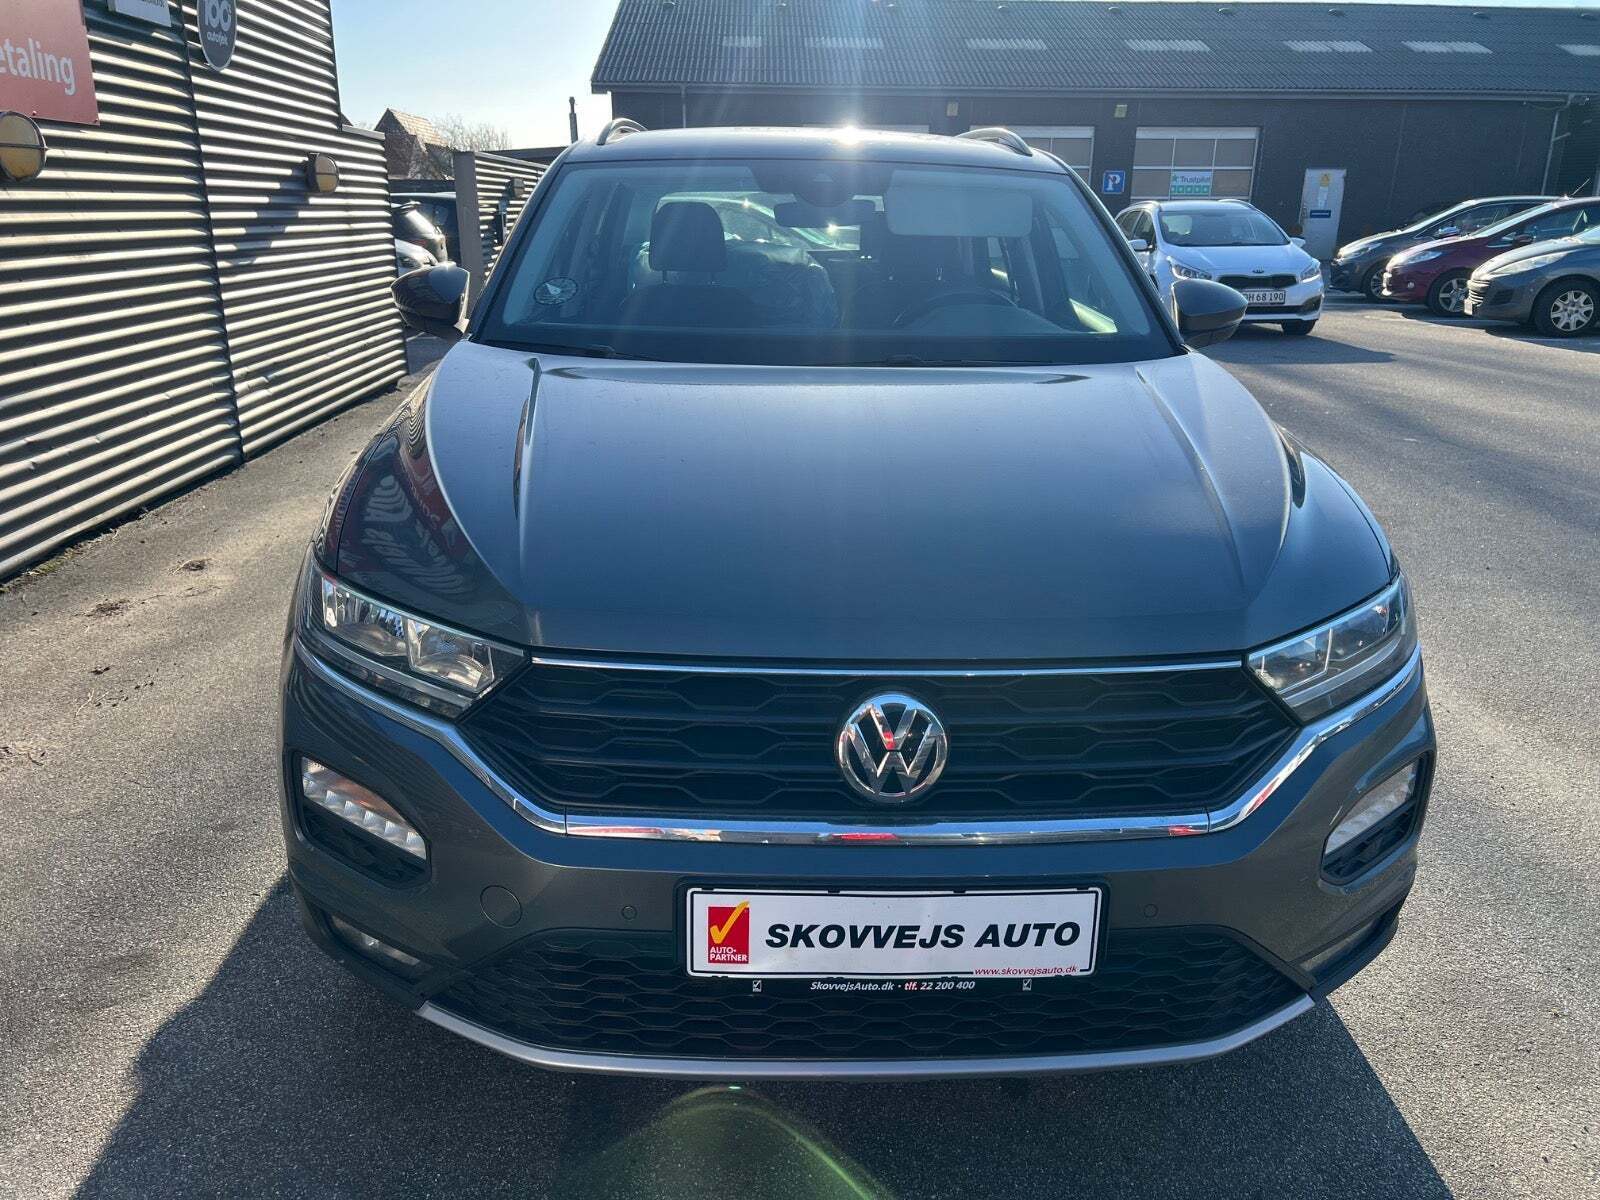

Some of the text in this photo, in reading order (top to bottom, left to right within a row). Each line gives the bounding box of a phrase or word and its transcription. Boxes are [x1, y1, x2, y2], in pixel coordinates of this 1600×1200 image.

[1256, 293, 1267, 301] 68
[1269, 292, 1284, 301] 190
[765, 921, 1081, 950] SKOVVEJS AUTO
[709, 953, 748, 962] PARTNER
[974, 965, 1078, 976] www.skovvejsauto.dk
[810, 980, 976, 992] SkovvejsAuto.dk tlf. 22 200 400
